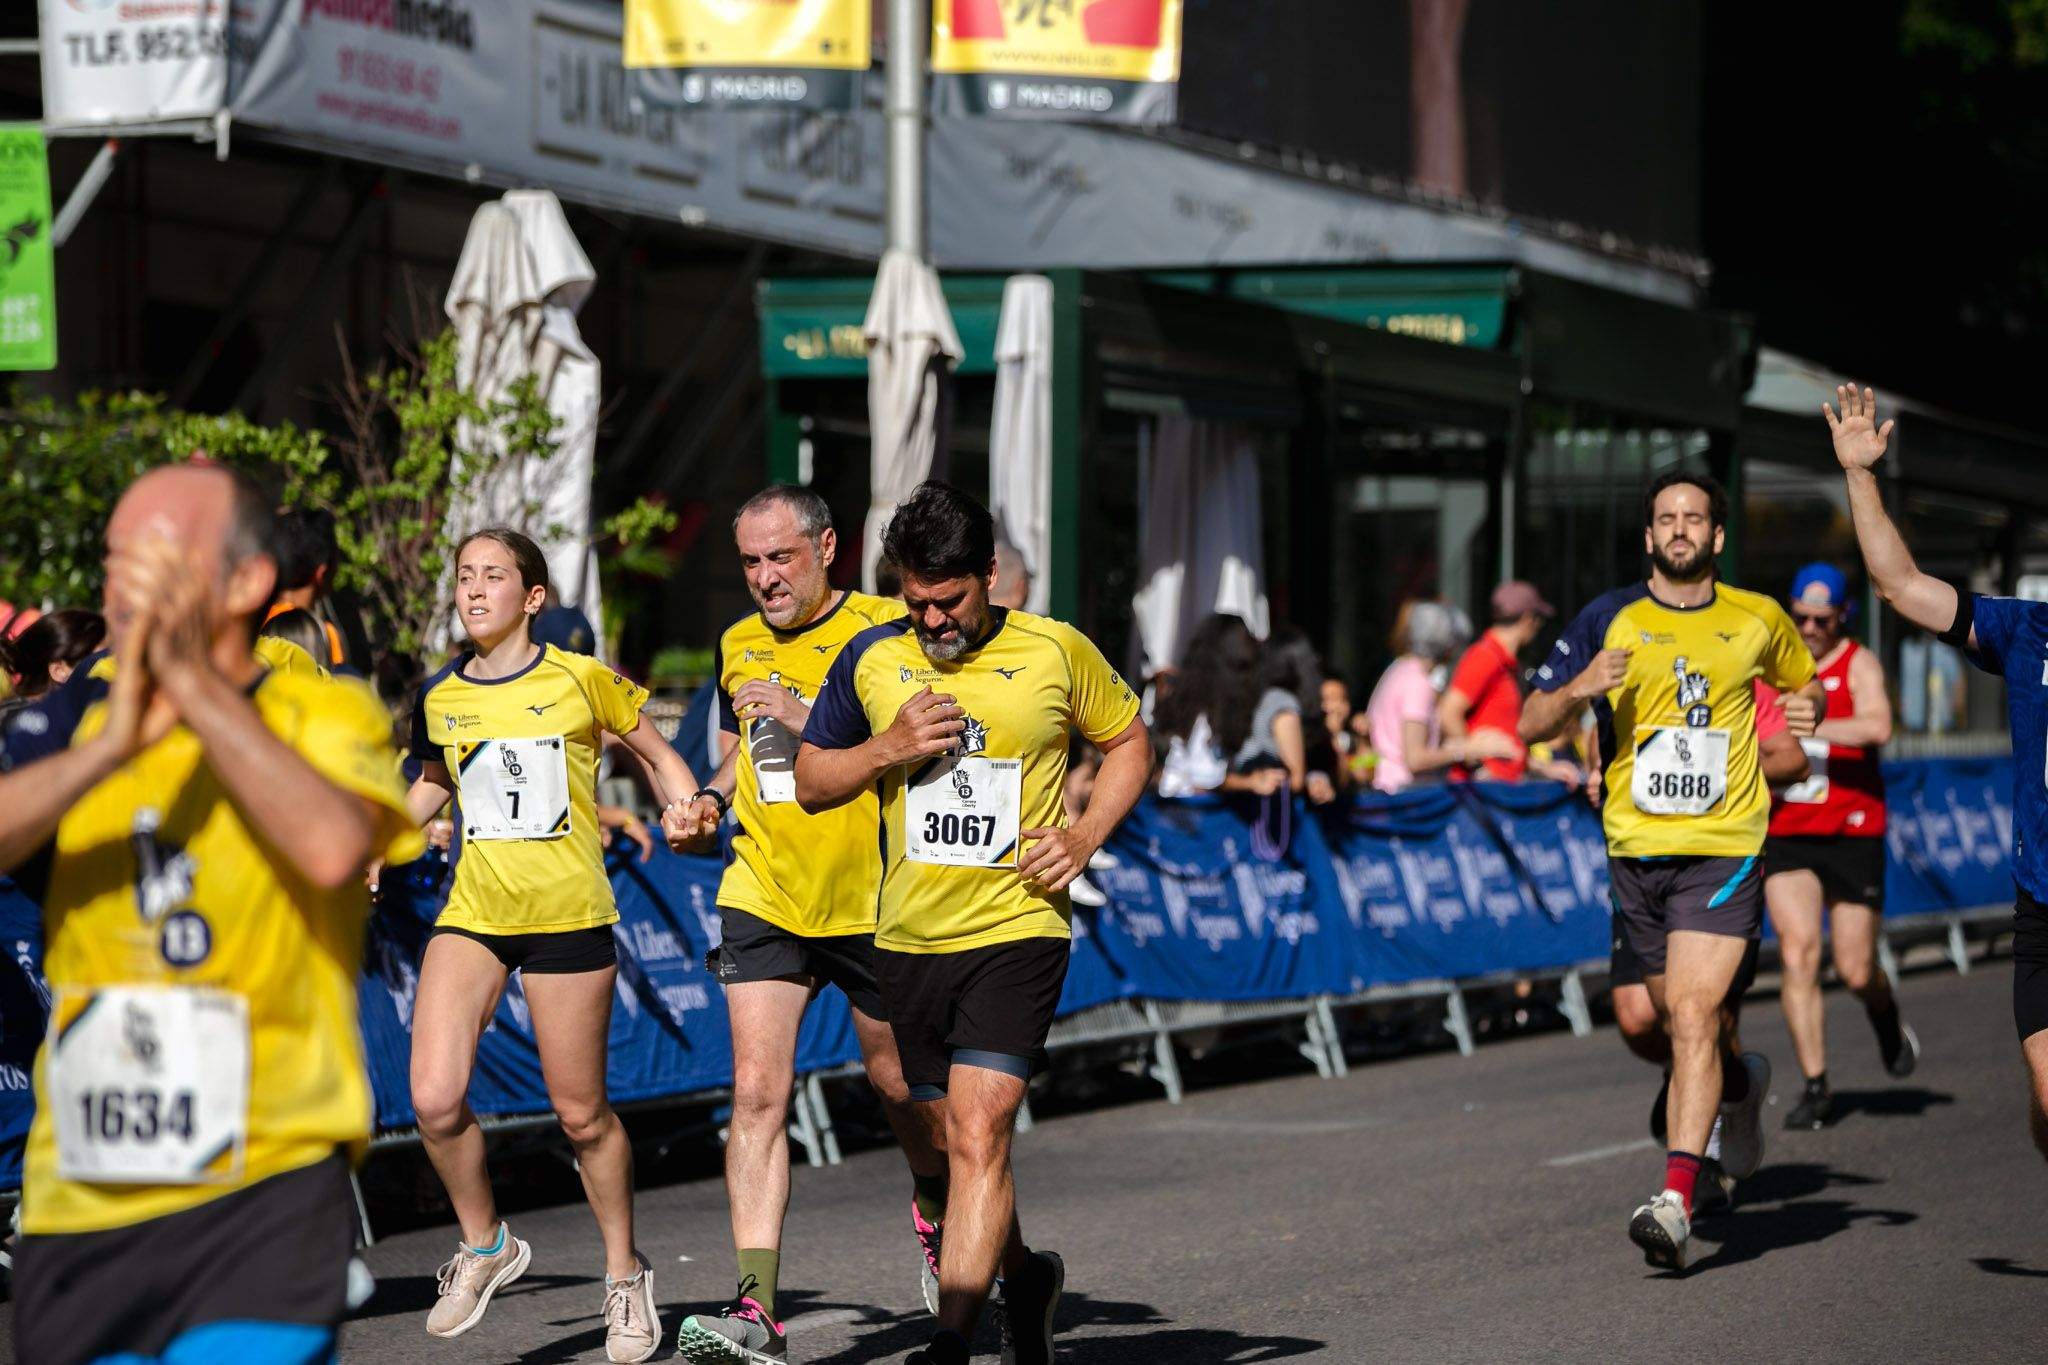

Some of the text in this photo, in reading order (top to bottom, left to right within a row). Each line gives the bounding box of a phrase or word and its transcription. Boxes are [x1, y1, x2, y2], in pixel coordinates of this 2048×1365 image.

[711, 77, 806, 101] MADRID
[1017, 84, 1113, 111] MADRID
[915, 668, 943, 677] Liberty
[961, 787, 971, 796] 13
[1648, 773, 1710, 799] 3688
[506, 790, 520, 820] 7
[924, 811, 996, 847] 3067
[79, 1092, 196, 1142] 1634
